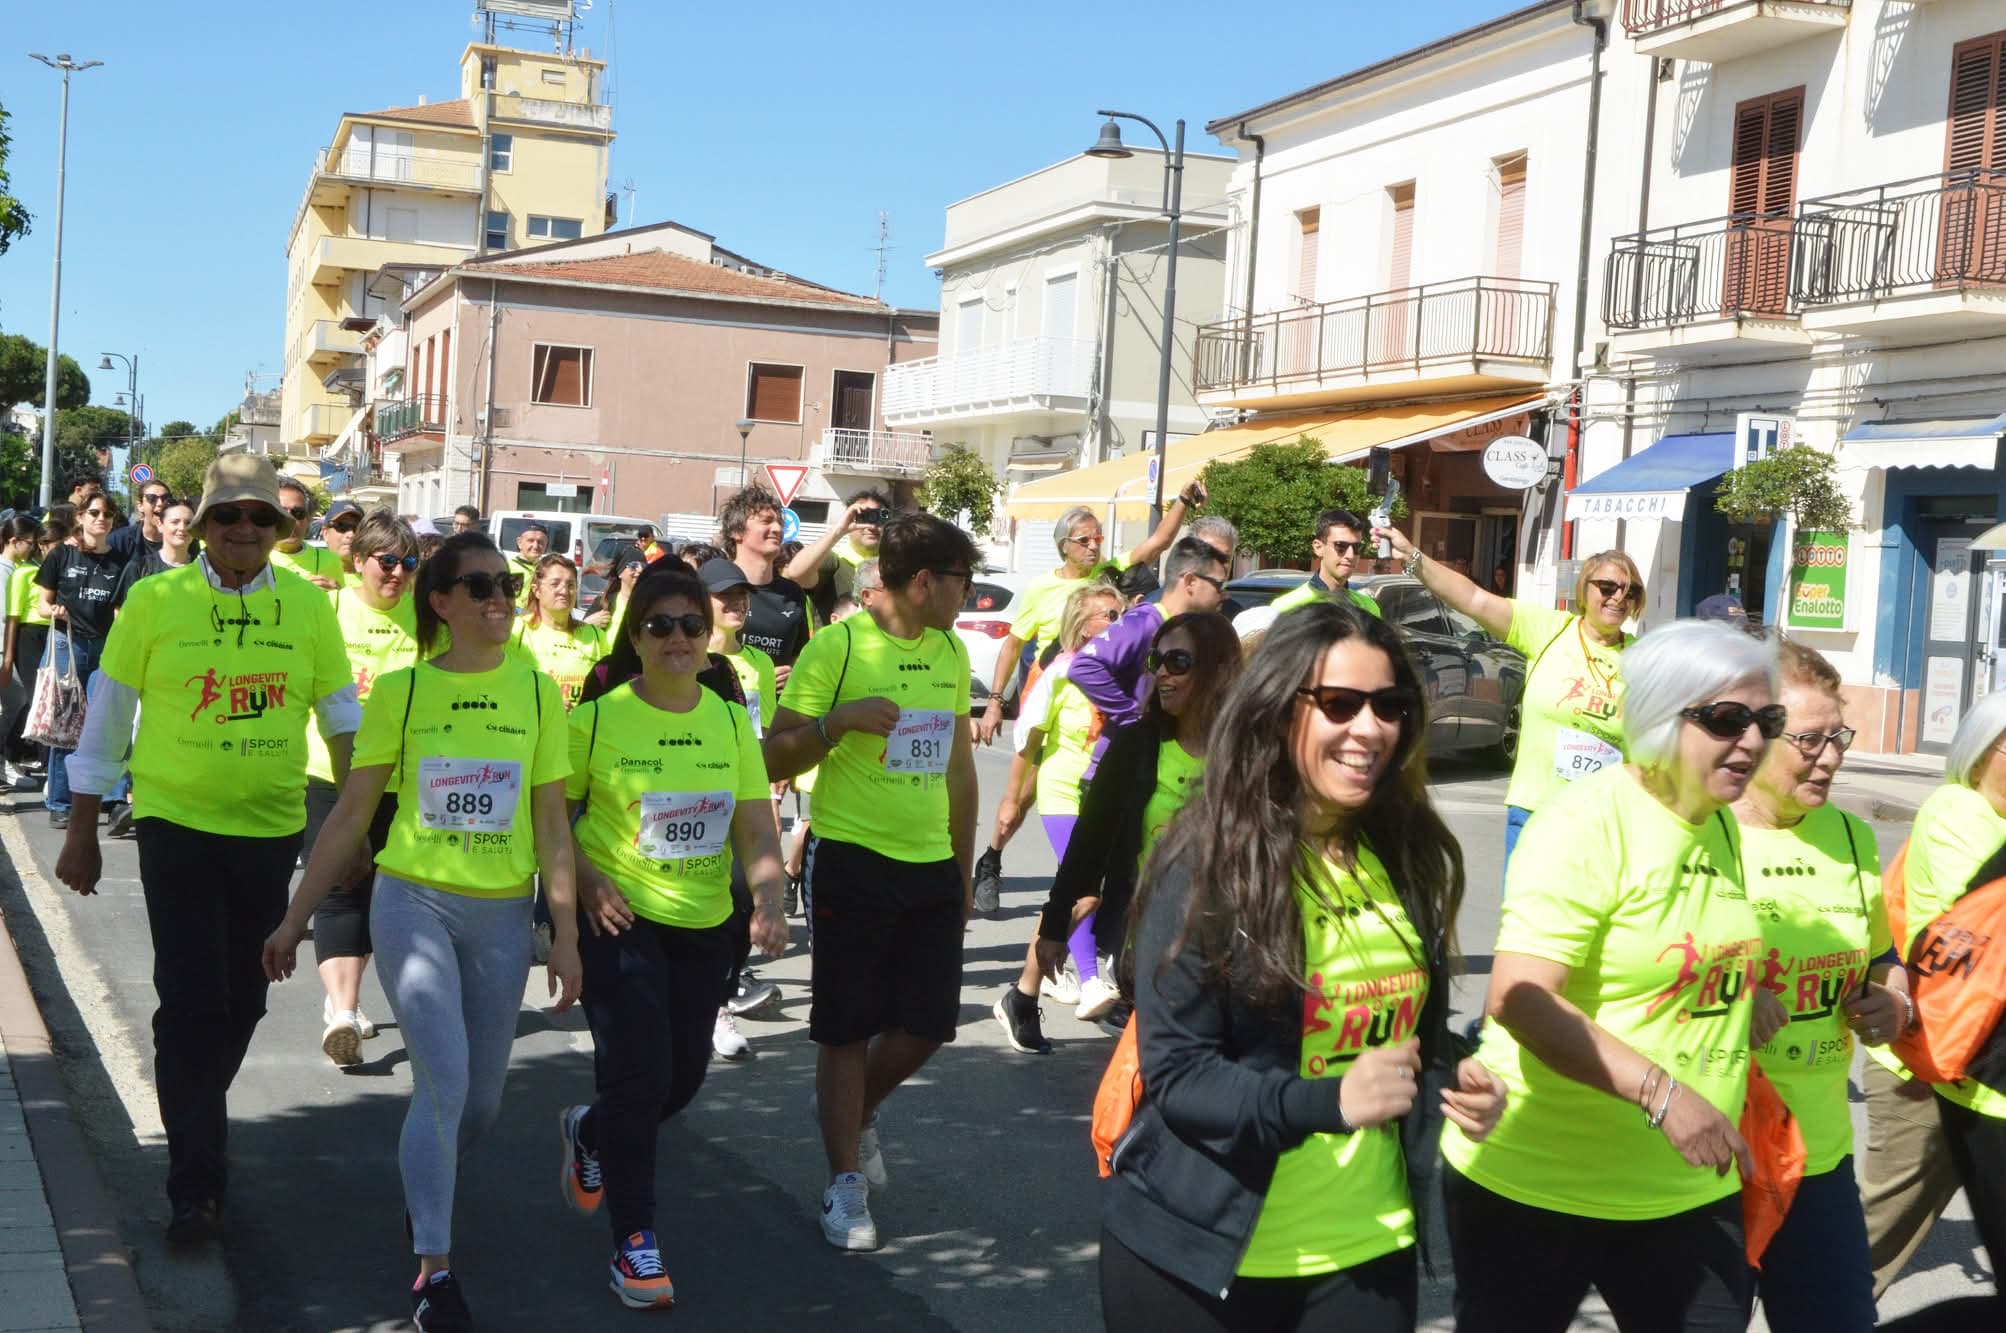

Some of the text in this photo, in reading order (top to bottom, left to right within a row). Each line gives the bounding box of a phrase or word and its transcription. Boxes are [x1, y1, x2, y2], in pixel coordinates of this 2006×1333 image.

[1780, 420, 1791, 449] LOT
[1486, 449, 1528, 462] CLASS
[1584, 497, 1667, 513] TABACCHI
[1796, 545, 1847, 567] LOTTO
[83, 587, 111, 597] SPORT
[1796, 583, 1829, 600] Super
[1793, 598, 1843, 617] Enalotto
[748, 634, 784, 648] SPORT
[229, 672, 288, 687] LONGEVITY
[230, 685, 286, 714] RUN
[898, 723, 933, 736] LONGEVITY
[249, 738, 289, 750] SPORT
[911, 739, 940, 758] 831
[620, 757, 664, 766] Danacol
[1572, 755, 1602, 773] 872
[430, 769, 512, 789] LONGEVITY RUN
[446, 792, 493, 815] 889
[652, 799, 725, 821] LONGEVITY RUN
[473, 833, 512, 845] SPORT
[665, 821, 705, 842] 890
[686, 854, 721, 870] SPORT
[1712, 937, 1762, 962] LONGEVIT
[1799, 948, 1868, 973] LONGEVITY
[1345, 968, 1428, 1004] LONGEVITY
[1697, 958, 1758, 1008] RUN
[1795, 966, 1866, 1012] RUN
[1333, 988, 1425, 1052] RUN
